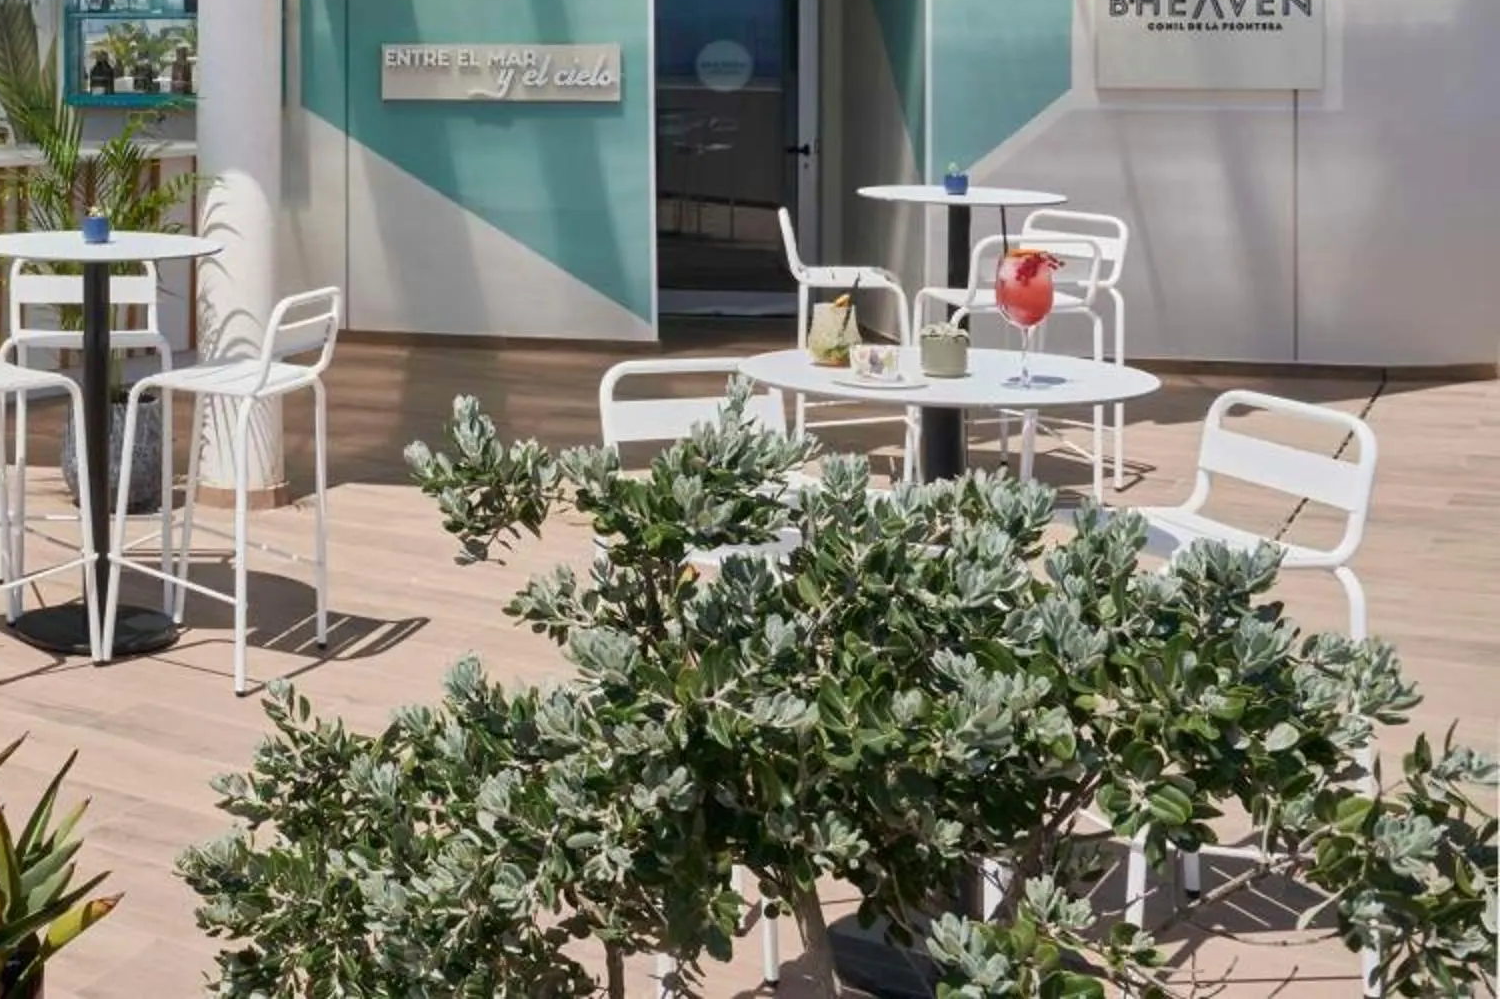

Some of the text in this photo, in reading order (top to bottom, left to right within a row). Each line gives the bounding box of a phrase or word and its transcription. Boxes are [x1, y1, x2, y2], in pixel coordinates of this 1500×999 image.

[1147, 22, 1185, 31] CONIL
[1187, 22, 1202, 31] DE
[1205, 22, 1219, 31] LA
[386, 49, 537, 67] ENTRE EL MAR
[522, 52, 551, 87] el
[553, 54, 616, 87] cielo
